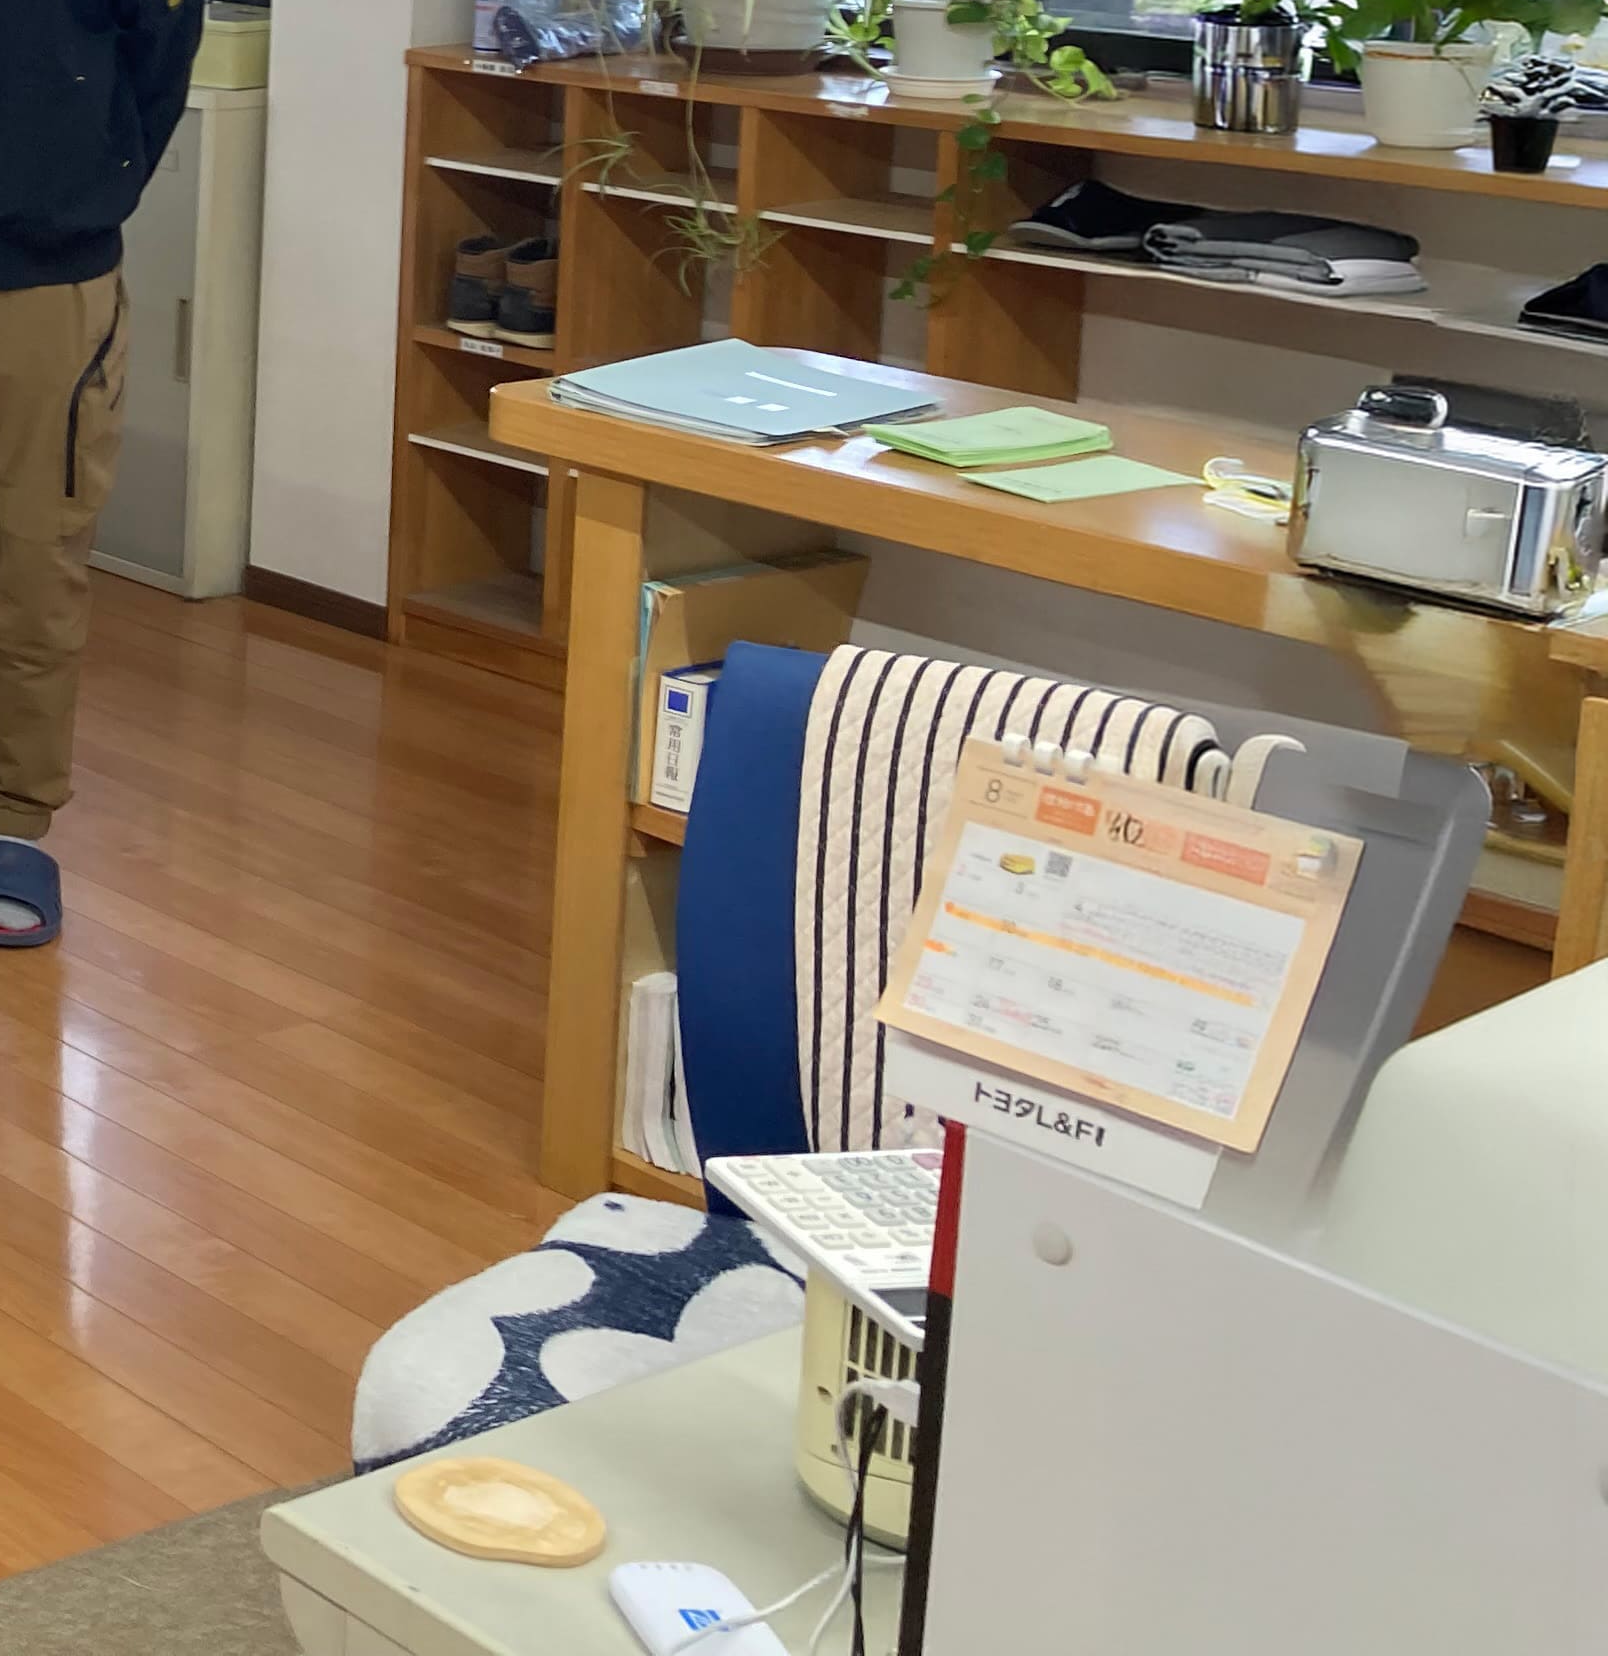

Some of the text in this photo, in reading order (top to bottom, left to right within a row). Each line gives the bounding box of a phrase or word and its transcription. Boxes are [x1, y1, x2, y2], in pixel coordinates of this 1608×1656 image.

[665, 724, 683, 781] 常用日報
[985, 779, 1003, 803] 8
